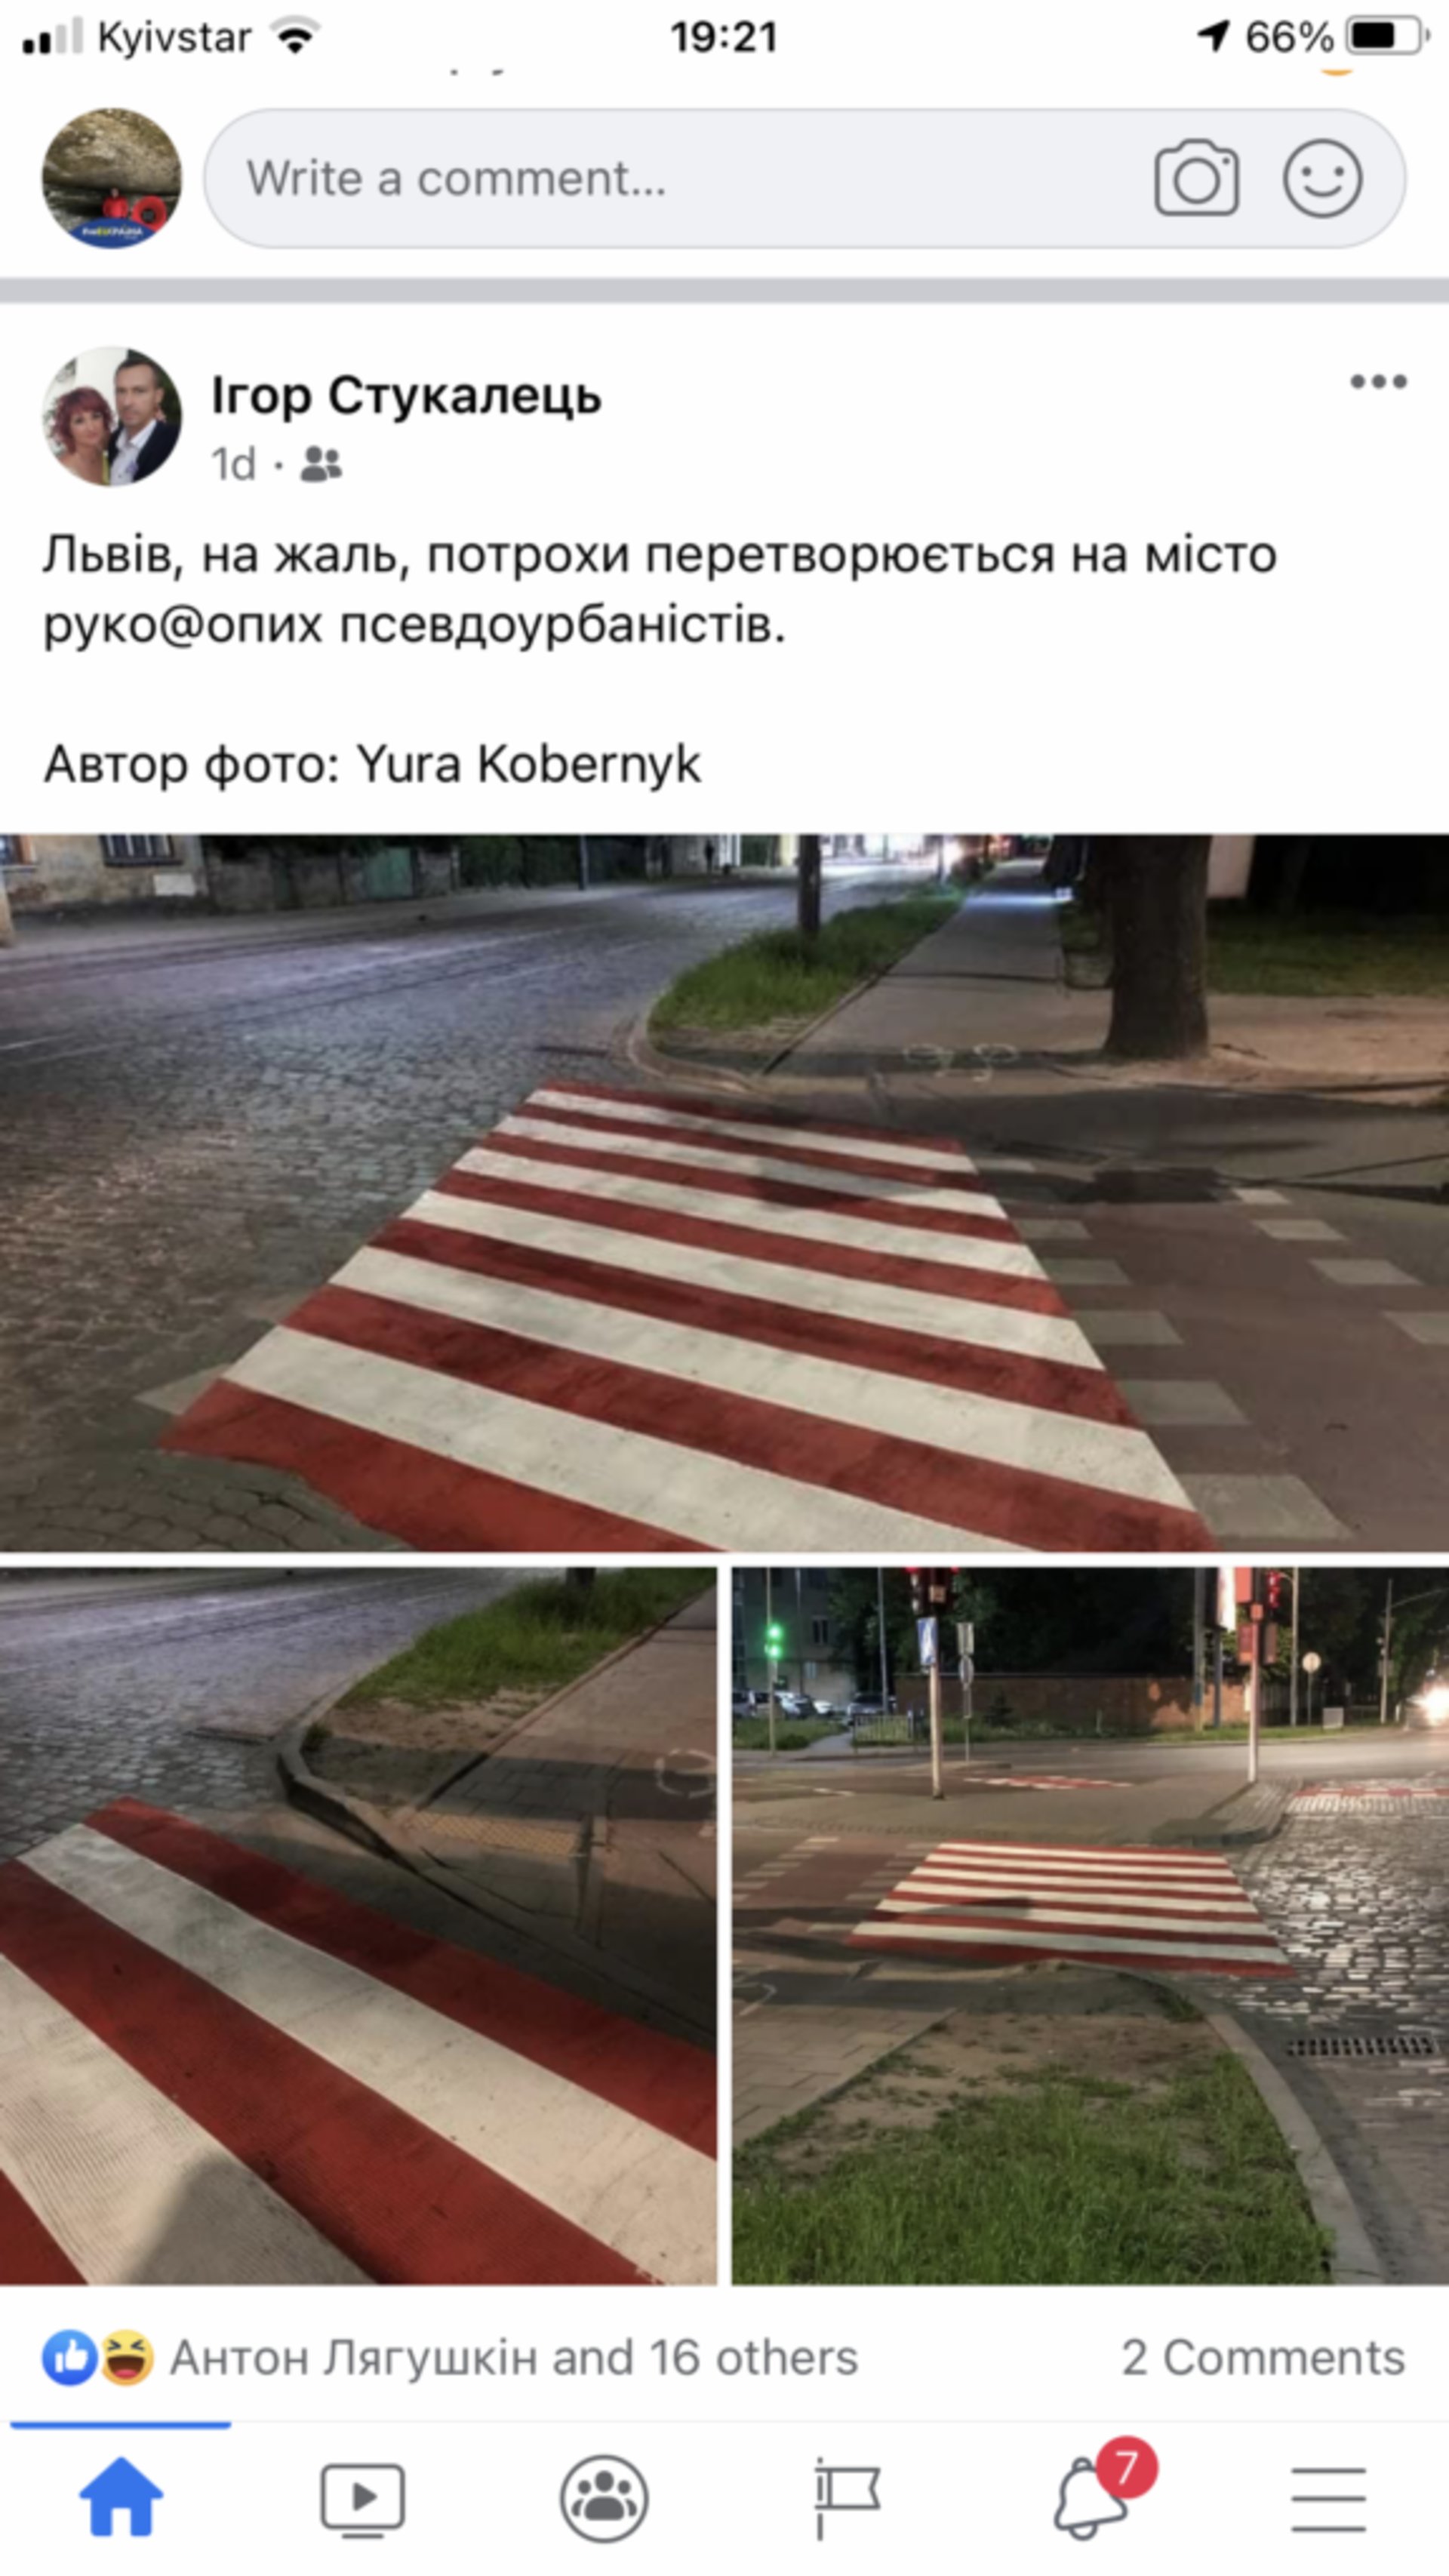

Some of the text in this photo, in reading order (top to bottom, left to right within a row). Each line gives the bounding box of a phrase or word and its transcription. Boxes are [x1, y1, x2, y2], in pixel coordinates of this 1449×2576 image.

[99, 19, 254, 61] Kyivstar
[670, 19, 777, 54] 19:21
[1245, 19, 1335, 54] 66%
[246, 157, 665, 197] Write a comment...
[213, 373, 603, 425] Ігор Стукалець
[211, 445, 256, 482] 1d
[41, 531, 1278, 583] Львів, на жаль, потрохи перетворюється на місто
[44, 601, 786, 653] руко@опих псевдоурбаністів.
[42, 741, 703, 793] Автор фото: Yura Kobernyk
[169, 2337, 859, 2385] Антон Лягушкін and 16 others
[1122, 2337, 1406, 2377] 2 Comments
[1115, 2450, 1139, 2485] 7
